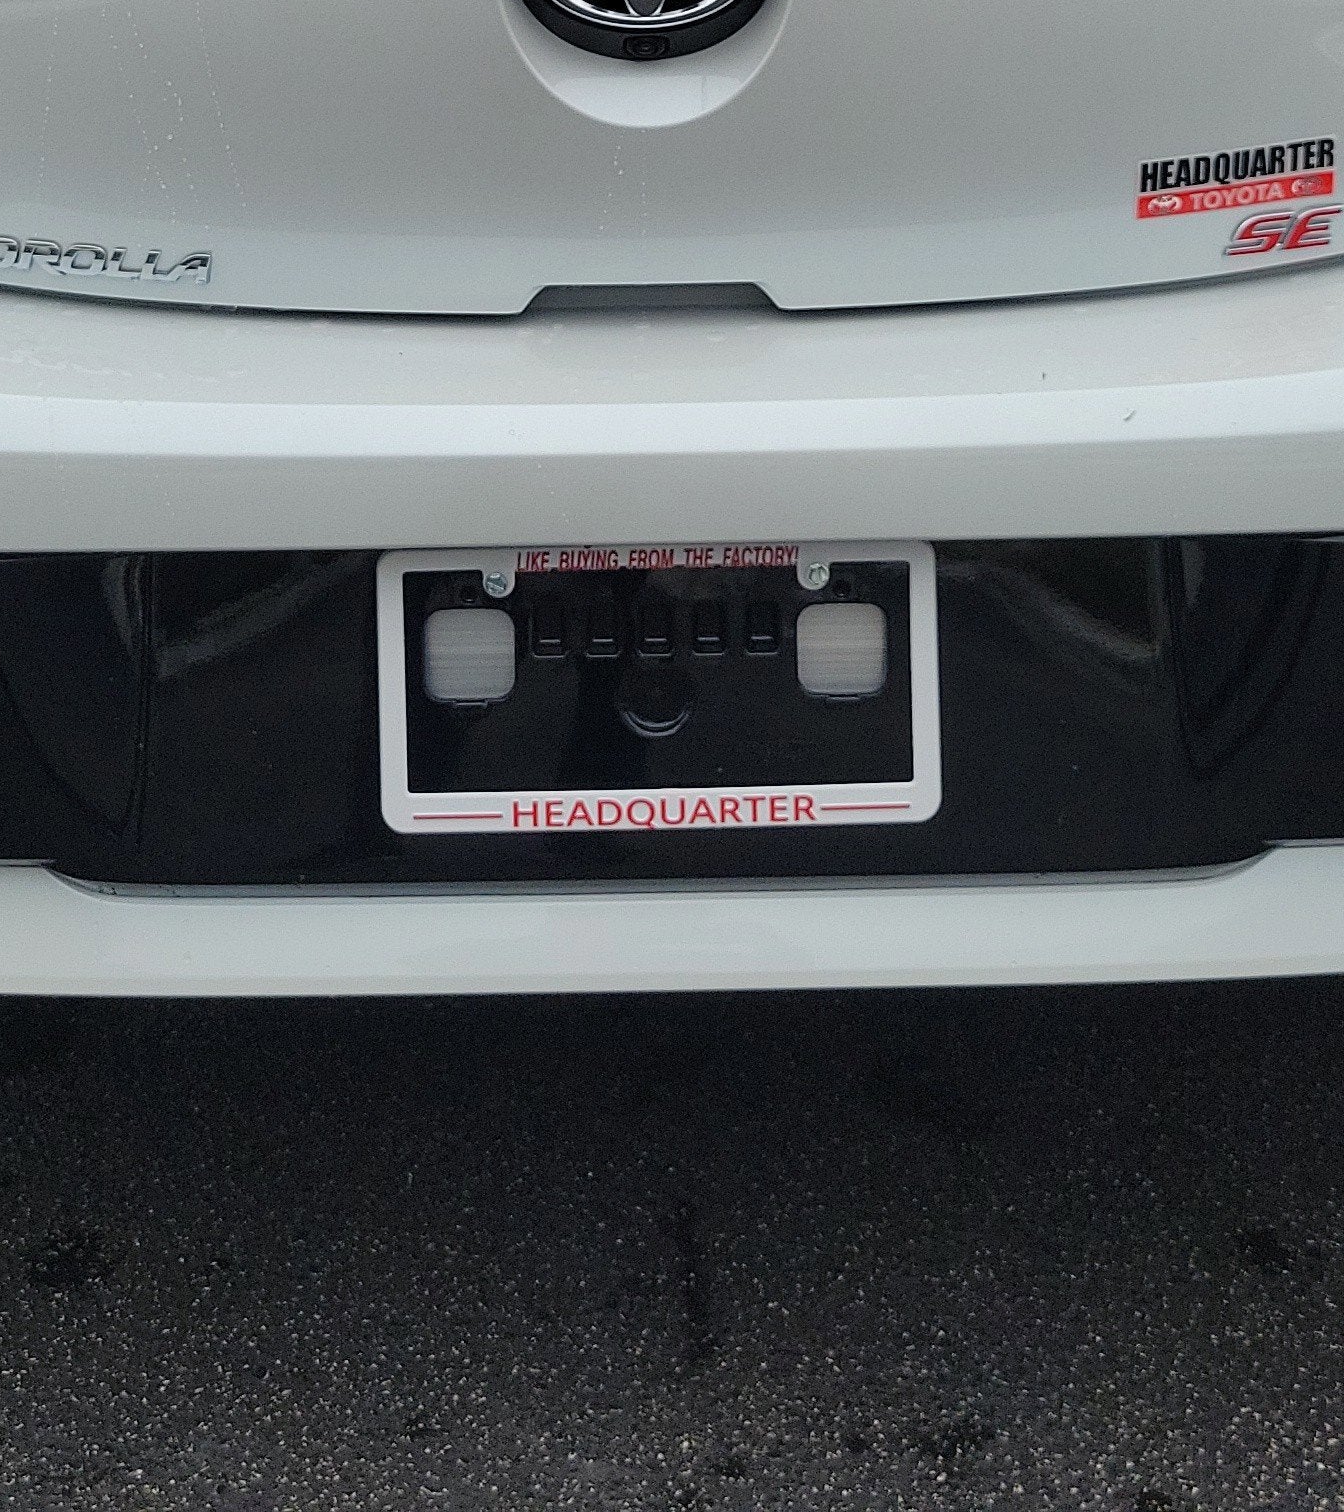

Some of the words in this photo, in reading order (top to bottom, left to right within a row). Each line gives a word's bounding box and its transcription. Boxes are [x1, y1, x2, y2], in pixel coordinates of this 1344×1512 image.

[1140, 137, 1335, 194] HEADQUARTER
[1188, 182, 1284, 212] TOYOTA
[1223, 202, 1344, 257] SE
[516, 550, 551, 571] LIKE
[559, 549, 619, 571] BUYING
[628, 548, 674, 569] FROM
[684, 547, 714, 568] THE
[723, 545, 799, 567] FACTORY!
[511, 794, 818, 830] HEADQUARTER
